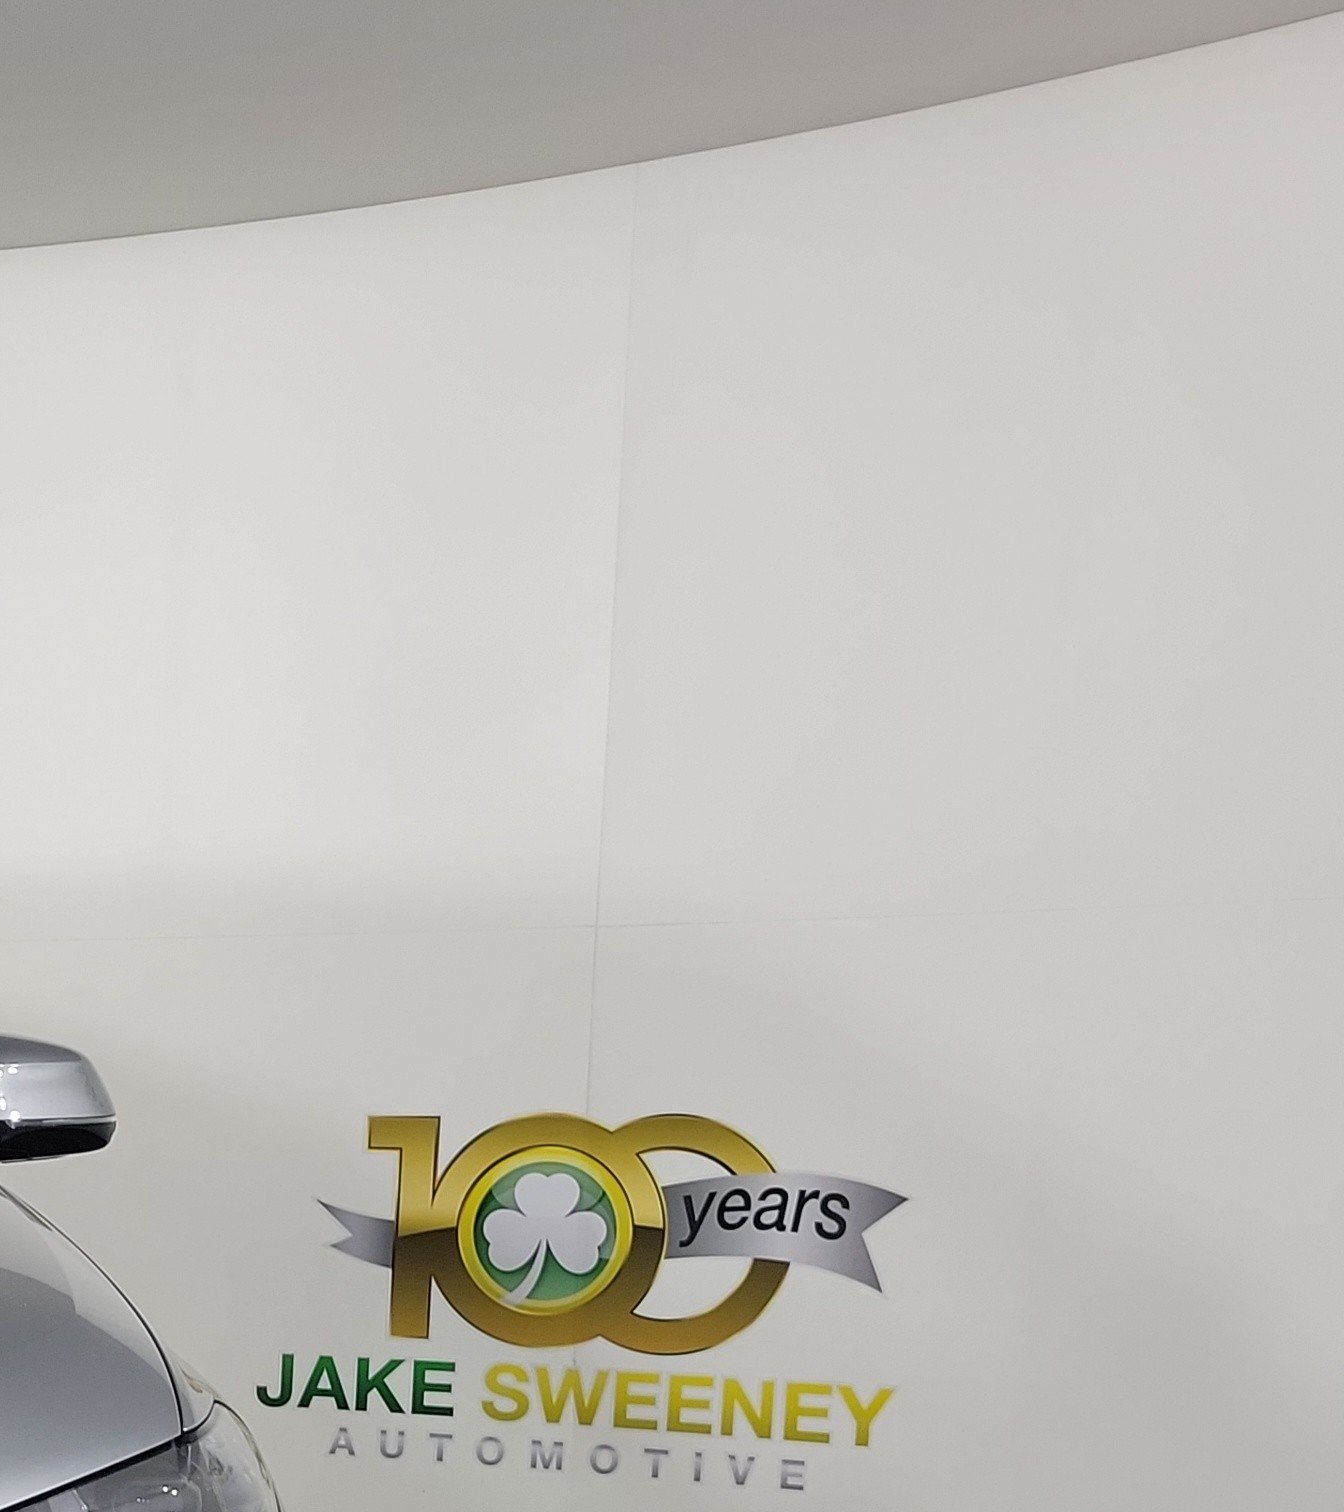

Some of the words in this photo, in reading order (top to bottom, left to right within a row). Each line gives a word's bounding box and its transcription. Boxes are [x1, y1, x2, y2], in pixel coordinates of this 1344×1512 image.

[367, 1111, 791, 1356] 100
[678, 1186, 850, 1247] years
[255, 1353, 456, 1417] JAKE
[481, 1362, 895, 1447] SWEENEY
[328, 1427, 806, 1491] AUTOMOTIVE
